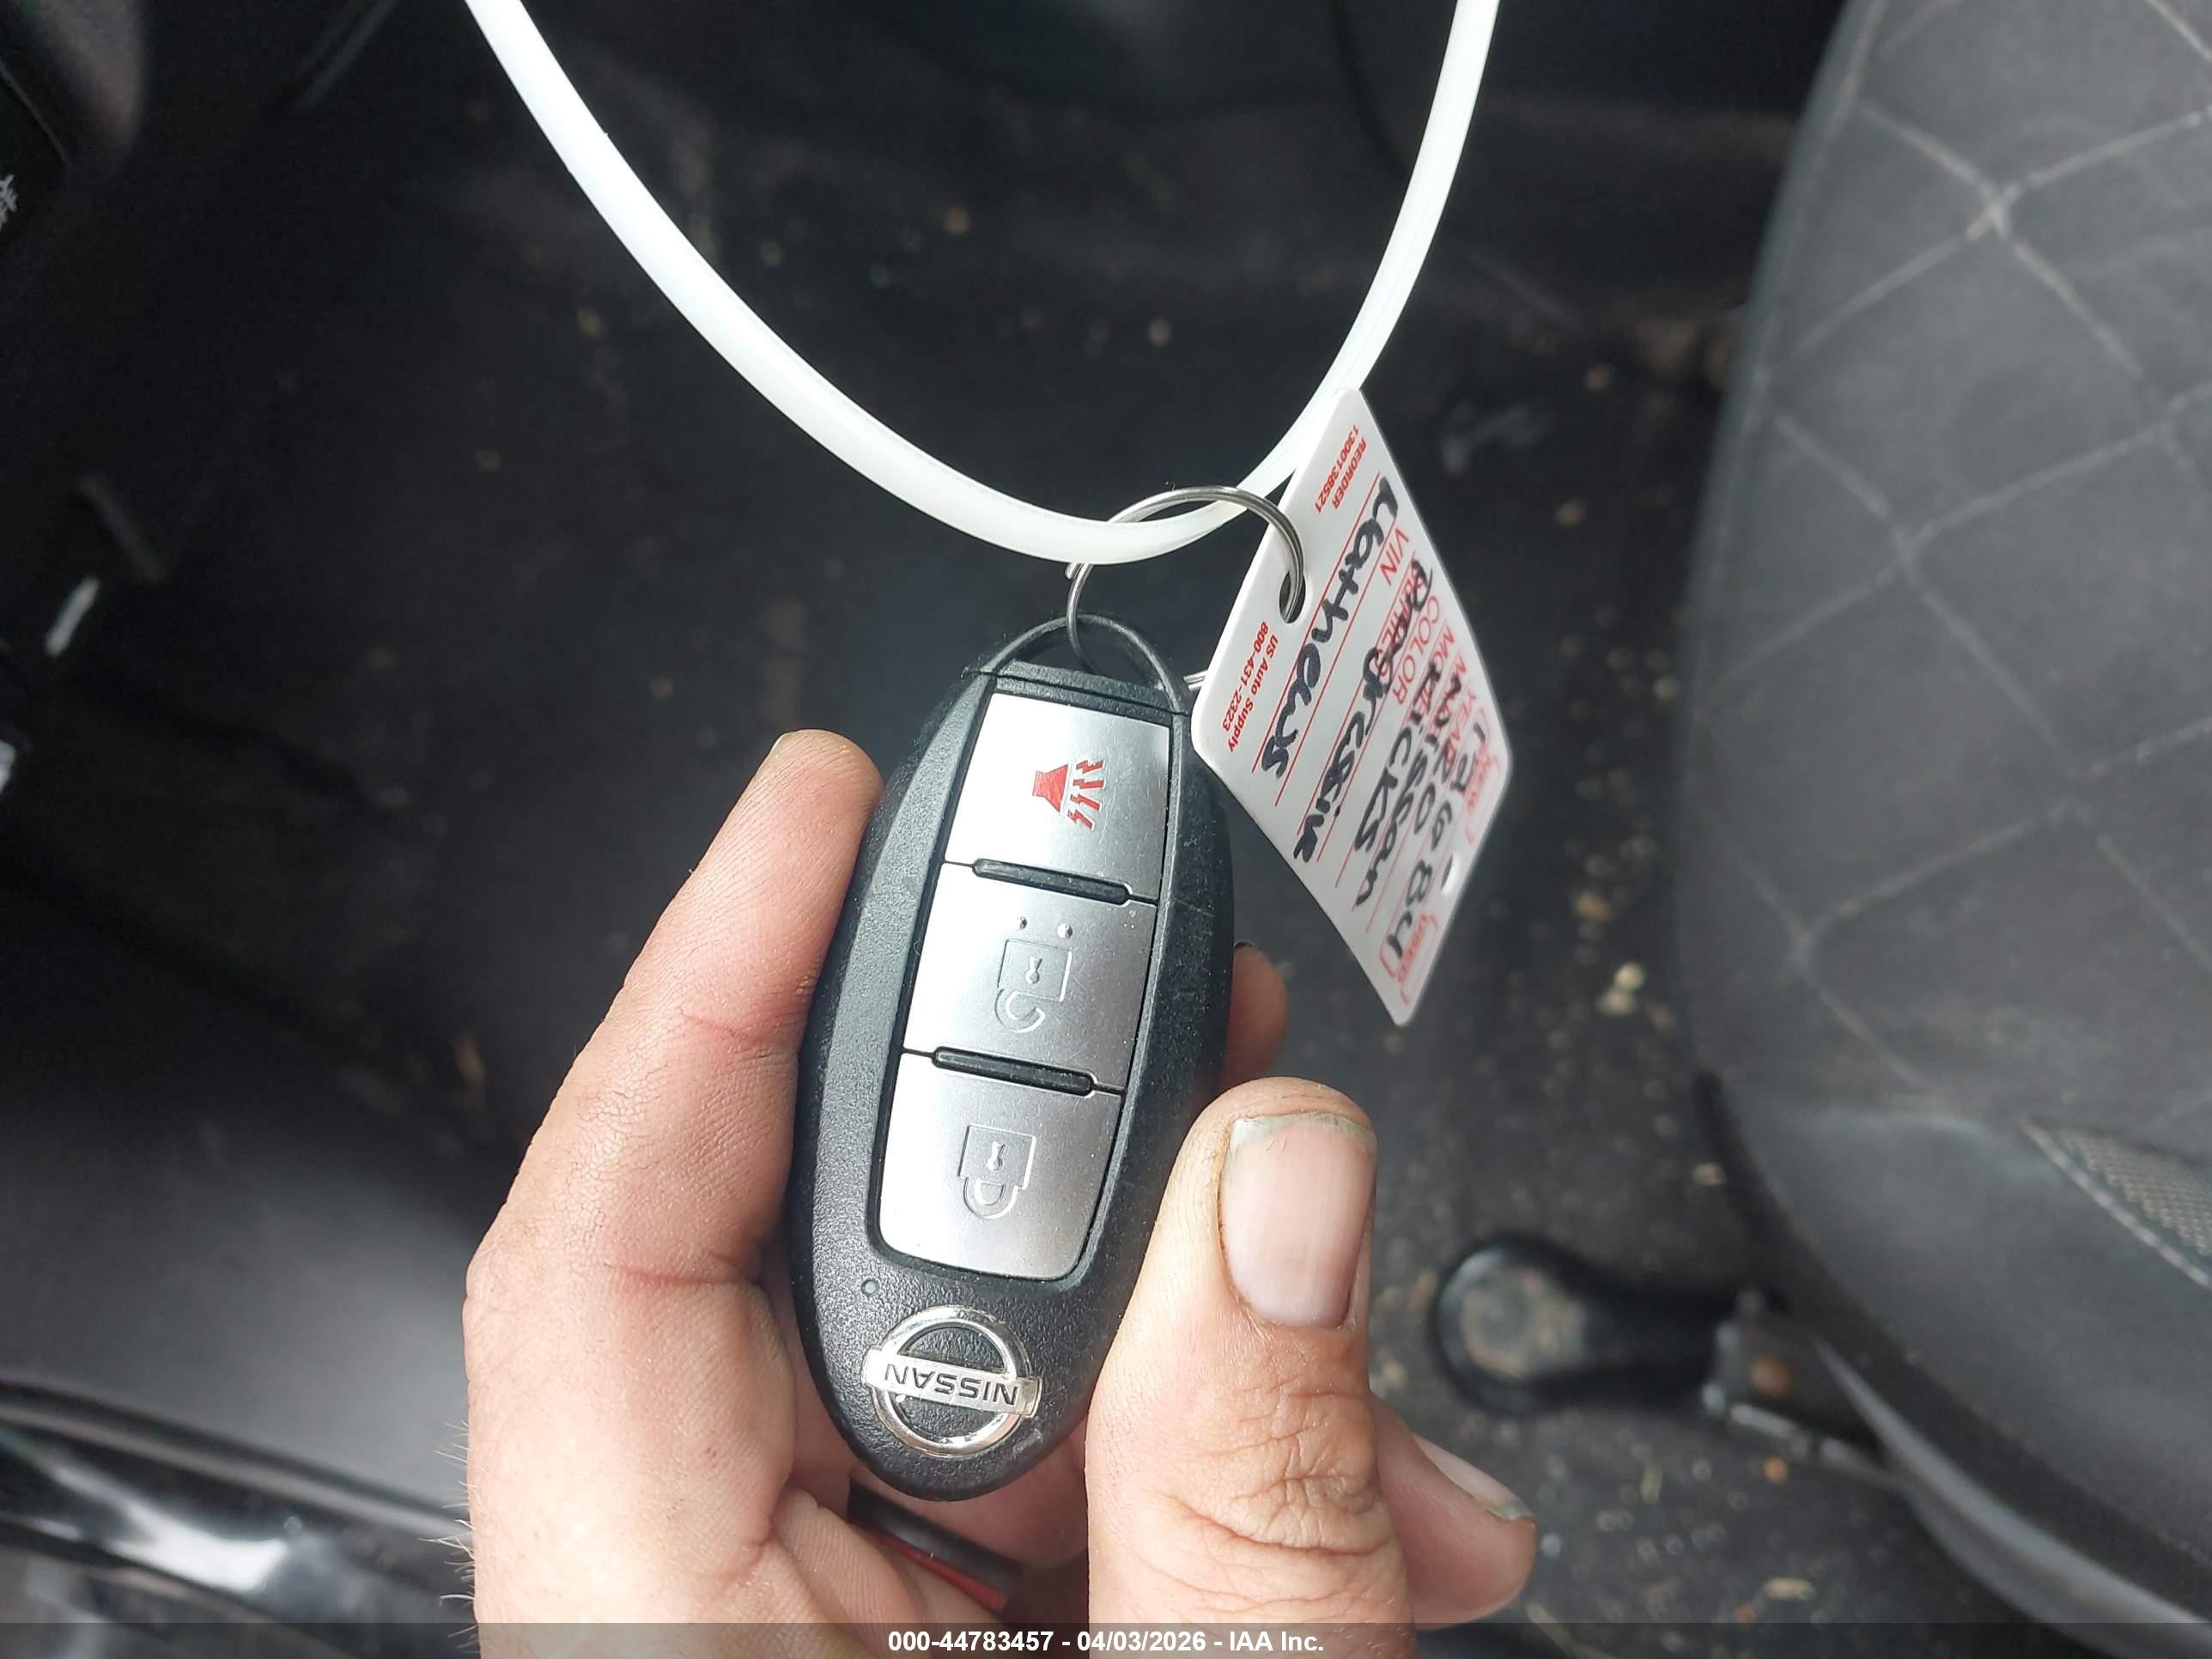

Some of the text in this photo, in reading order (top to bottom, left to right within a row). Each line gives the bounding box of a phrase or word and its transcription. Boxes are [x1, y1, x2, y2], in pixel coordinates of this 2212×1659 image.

[1331, 434, 1366, 511] REORDER
[1379, 522, 1409, 587] VIN
[1221, 620, 1268, 733] 800-431-2323
[1227, 633, 1279, 753] US Auto Supply
[1391, 593, 1441, 708] COLOR
[884, 1364, 1018, 1406] NISSAN
